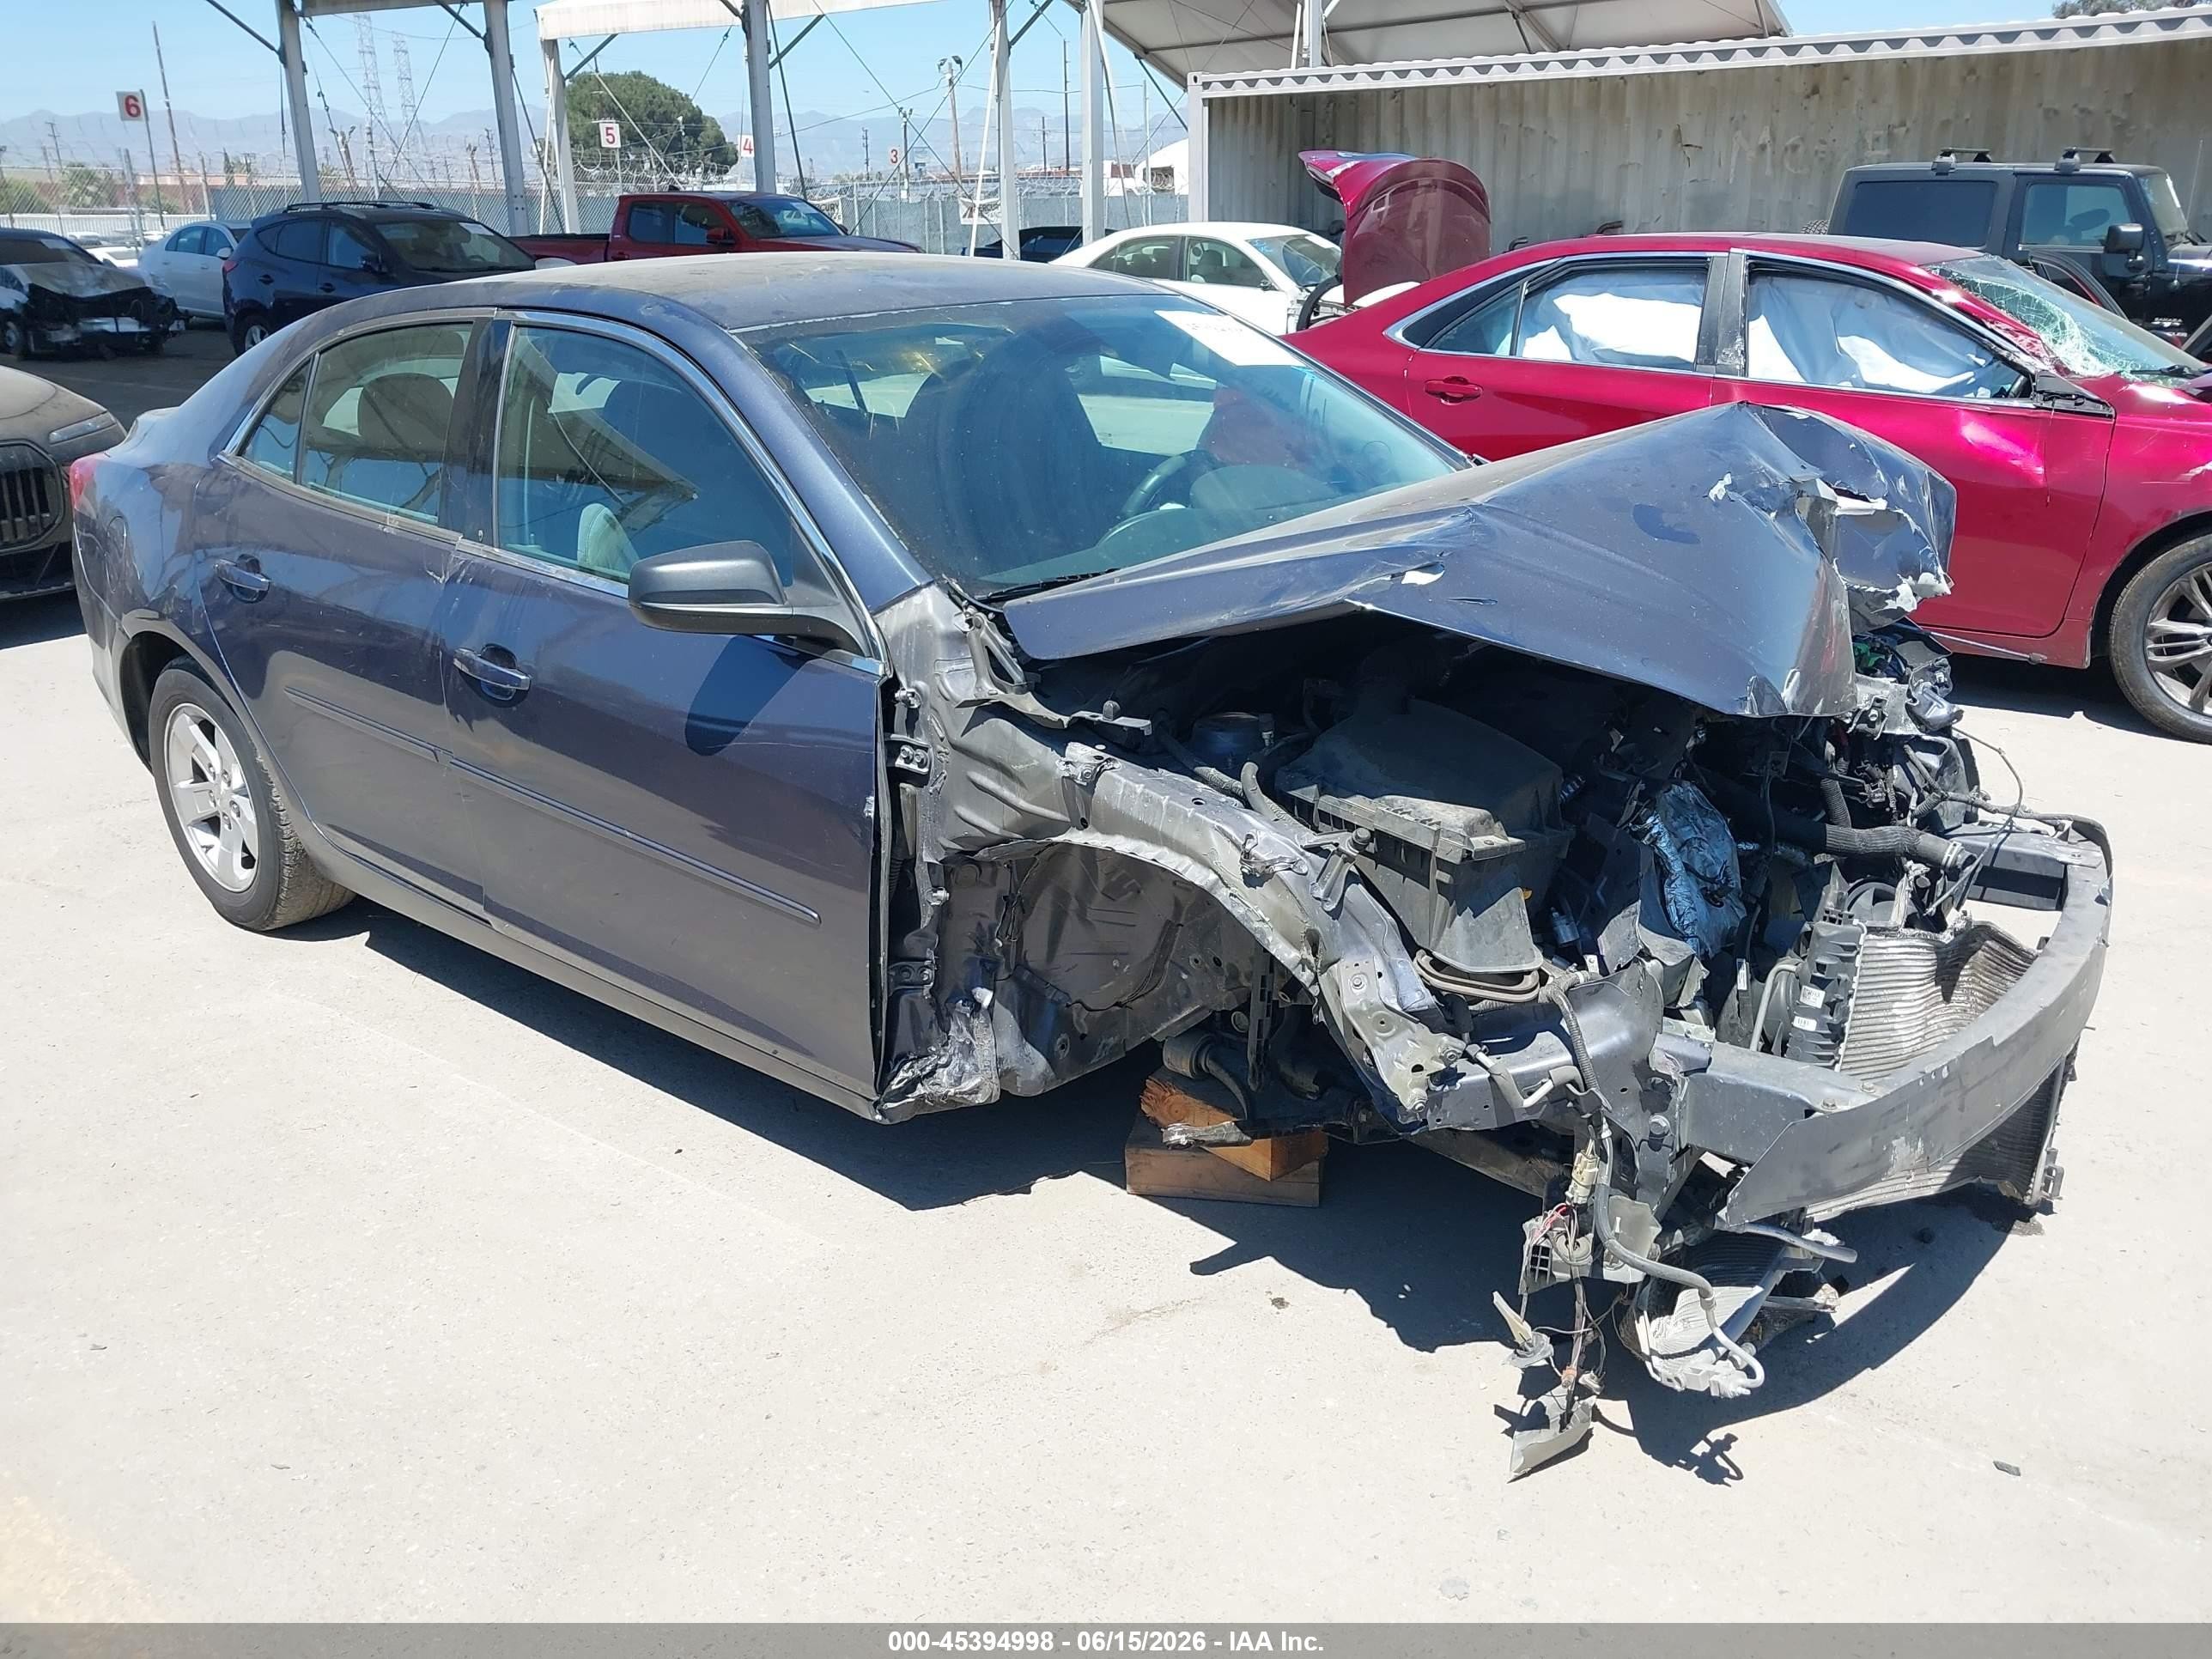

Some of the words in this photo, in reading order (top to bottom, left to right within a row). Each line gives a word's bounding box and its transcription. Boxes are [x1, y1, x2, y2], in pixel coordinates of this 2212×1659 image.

[125, 94, 141, 118] 6
[605, 126, 616, 144] 5
[743, 137, 753, 155] 4
[890, 149, 898, 164] 3
